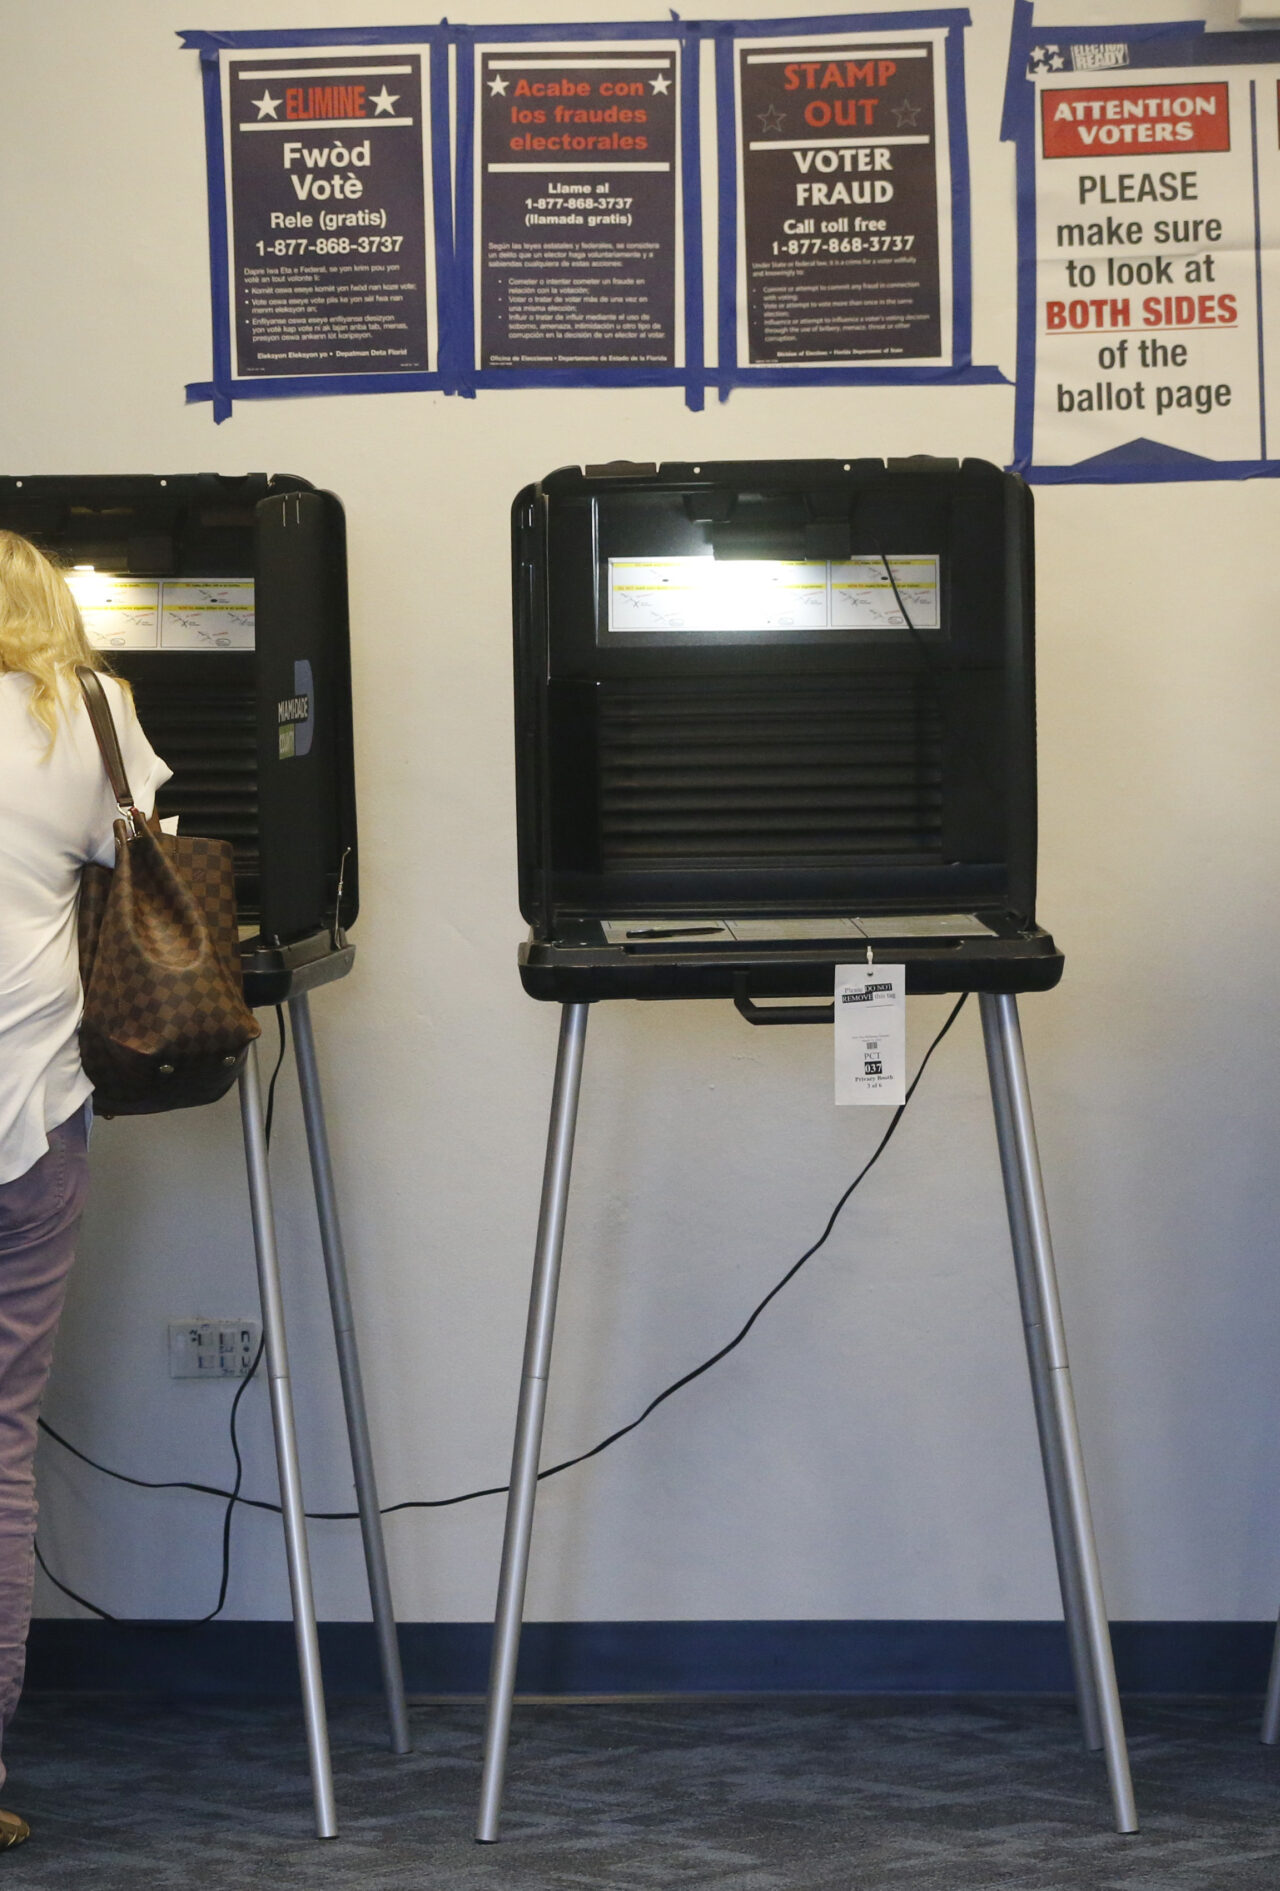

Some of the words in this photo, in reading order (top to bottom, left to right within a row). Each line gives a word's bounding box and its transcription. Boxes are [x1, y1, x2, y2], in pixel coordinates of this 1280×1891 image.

[1076, 54, 1126, 68] READY
[784, 60, 897, 90] STAMP
[515, 79, 591, 97] Acabe
[599, 82, 644, 97] con
[286, 84, 367, 121] ELIMINE
[804, 99, 879, 127] OUT
[1054, 96, 1216, 122] ATTENTION
[511, 107, 547, 124] los
[554, 106, 648, 123] fraudes
[509, 133, 648, 150] electorales
[1078, 121, 1194, 145] VOTERS
[283, 140, 371, 169] Fwòd
[793, 148, 893, 173] VOTER
[291, 172, 363, 200] Votè
[548, 183, 592, 194] Llame
[596, 183, 609, 193] al
[796, 180, 894, 206] FRAUD
[1079, 171, 1198, 205] PLEASE
[525, 198, 633, 209] 1-877-868-3737
[271, 211, 313, 229] Rele
[320, 209, 387, 231] (gratis)
[525, 214, 584, 226] (llamada
[588, 214, 632, 227] gratis)
[783, 219, 814, 234] Call
[821, 218, 848, 233] toll
[854, 216, 886, 232] free
[1057, 216, 1143, 247] make
[1154, 219, 1222, 244] sure
[256, 236, 404, 256] 1-877-868-3737
[772, 235, 915, 255] 1-877-868-3737
[1067, 259, 1096, 288] to
[1107, 255, 1173, 287] look
[1185, 254, 1215, 283] at
[1047, 299, 1130, 329] BOTH
[1144, 294, 1237, 326] SIDES
[1099, 339, 1128, 370] of
[1139, 338, 1187, 368] the
[1057, 381, 1145, 413] ballot
[1156, 384, 1231, 415] page
[864, 1052, 880, 1060] PCT
[865, 1064, 882, 1073] 037
